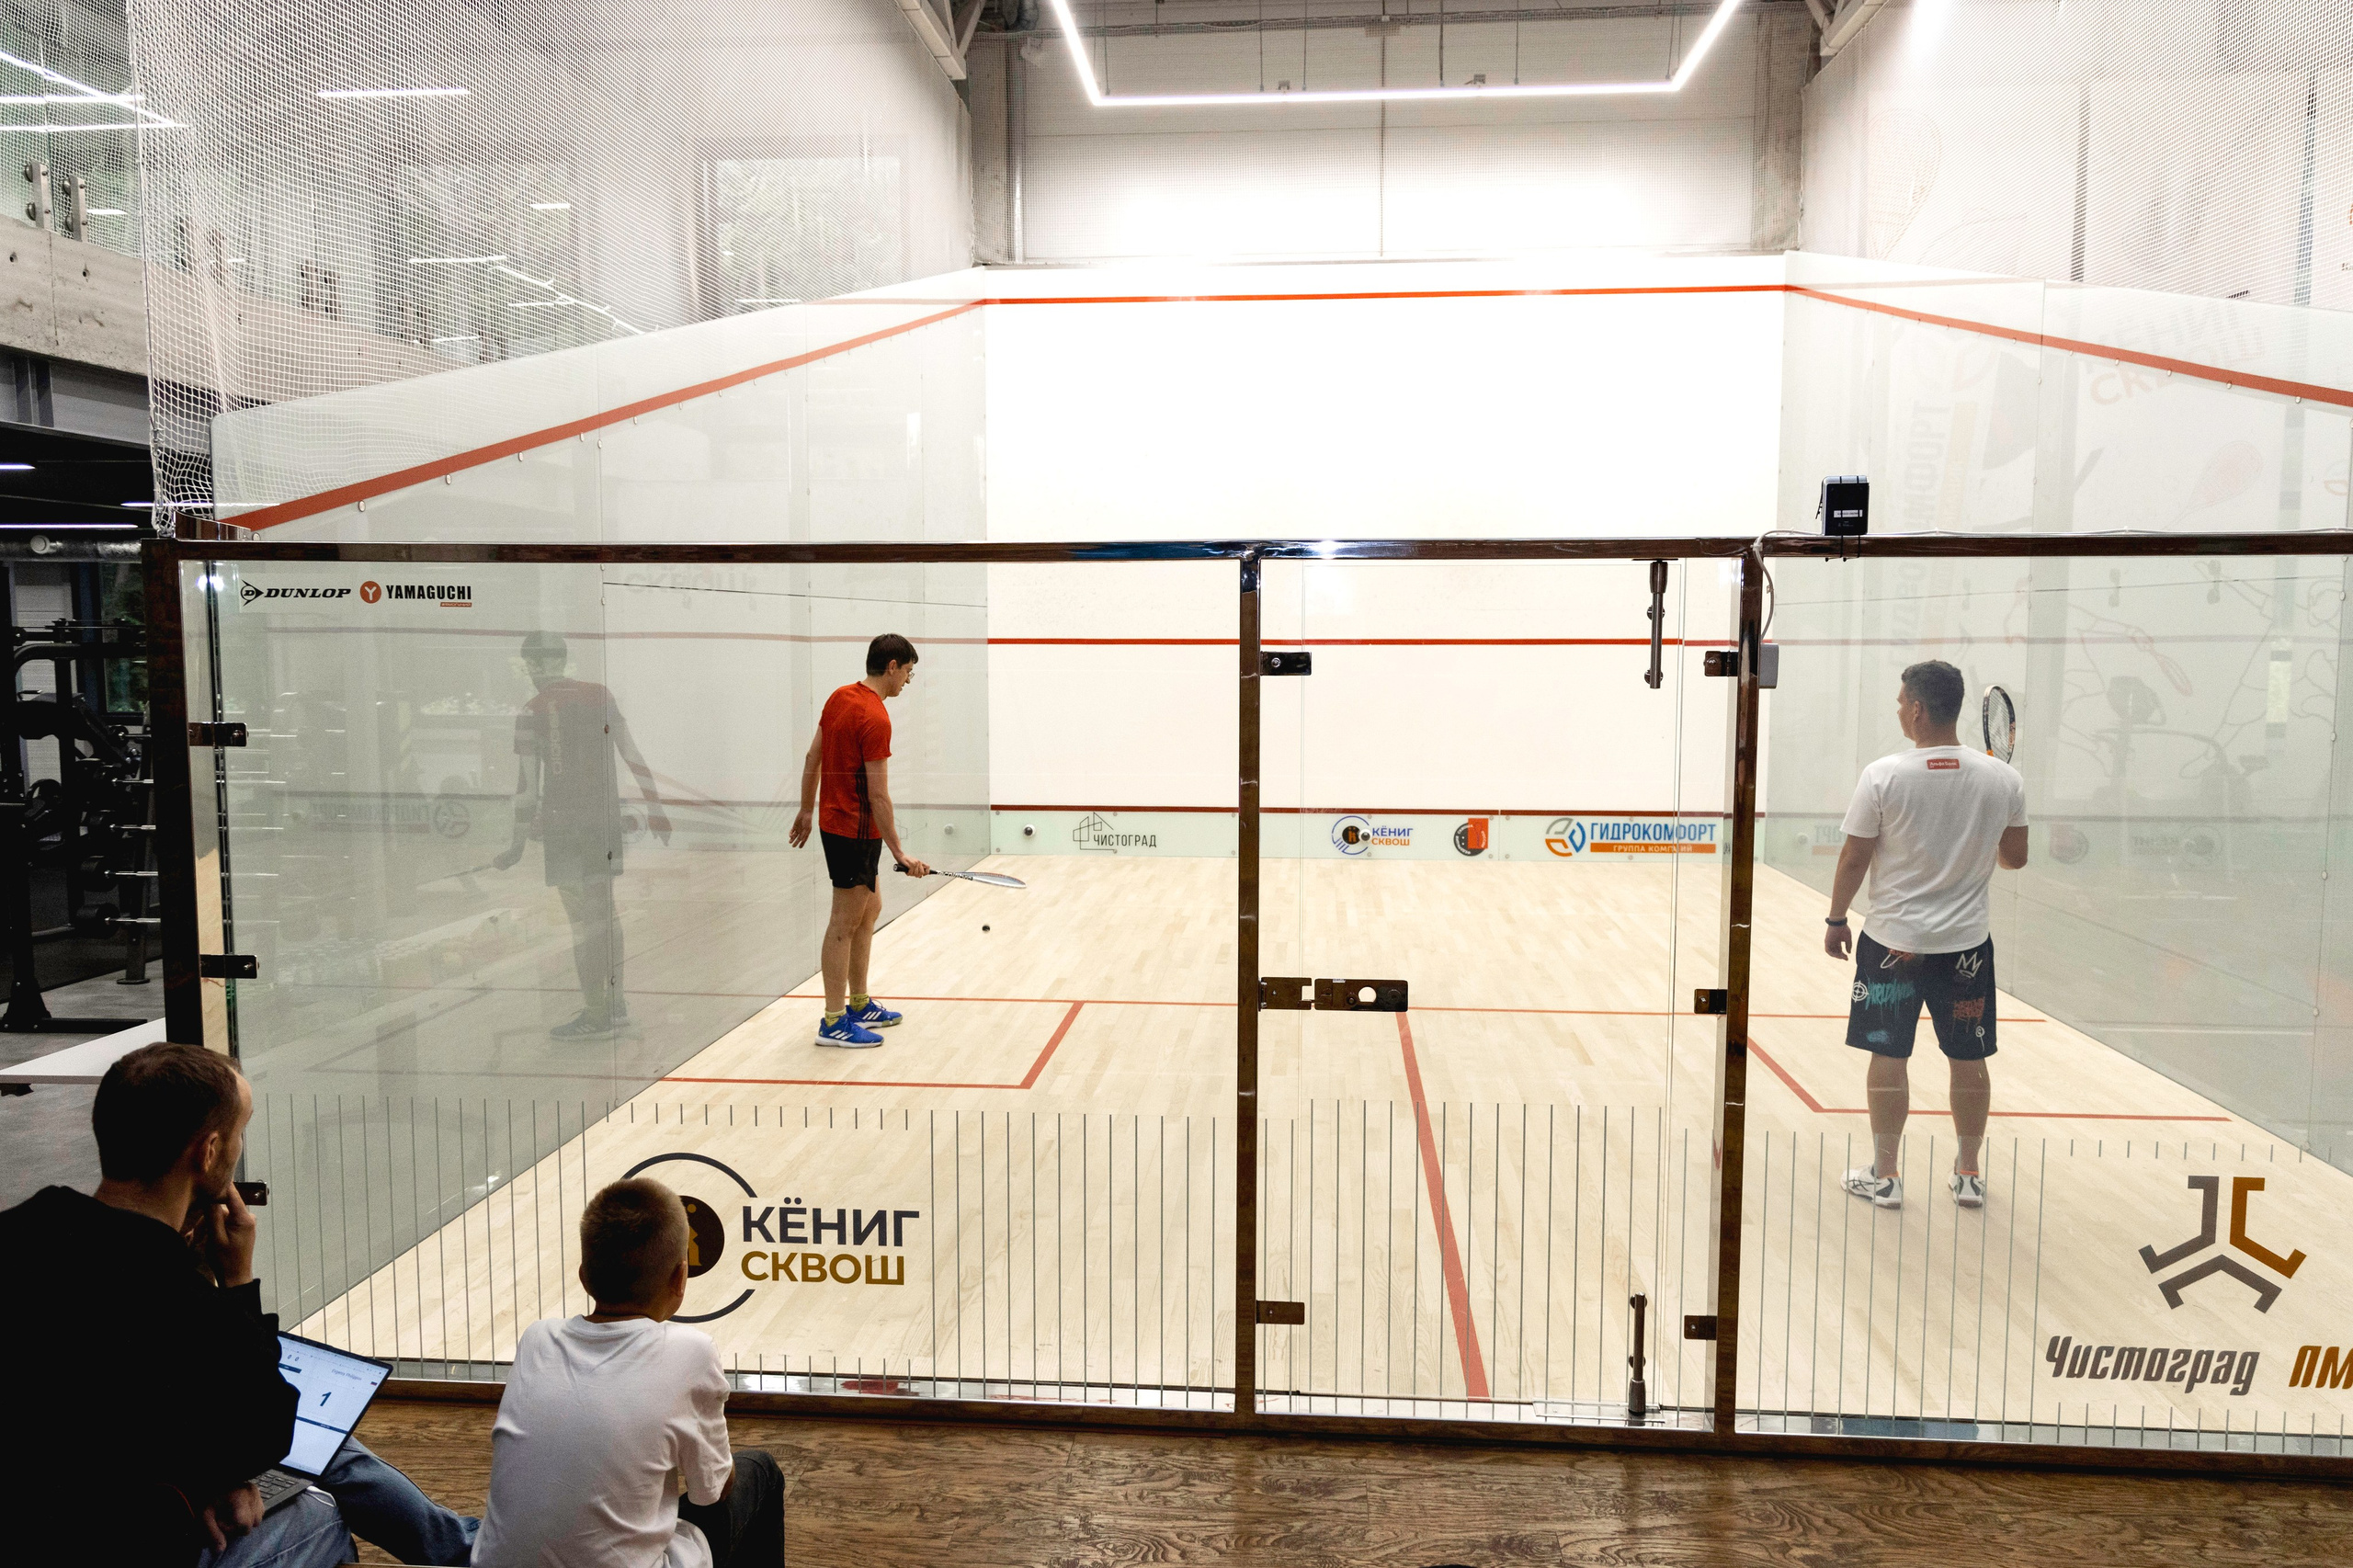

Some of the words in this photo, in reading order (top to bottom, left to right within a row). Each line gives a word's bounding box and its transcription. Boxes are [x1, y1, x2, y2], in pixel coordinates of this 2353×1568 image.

[264, 588, 351, 598] DUNLOP
[386, 585, 472, 600] YAMAGUCHI
[1371, 825, 1414, 837] КЁНИГ
[1590, 823, 1716, 841] ГИДРОКОМФОРТ
[1093, 834, 1157, 847] ЧИСТОГРАД
[1371, 837, 1410, 846] СКВОШ
[1648, 844, 1693, 853] КОМПИЙ
[742, 1197, 920, 1247] КЁНИГ
[741, 1251, 904, 1286] СКВОШ
[2045, 1335, 2260, 1396] Чистоград
[320, 1392, 332, 1406] 1
